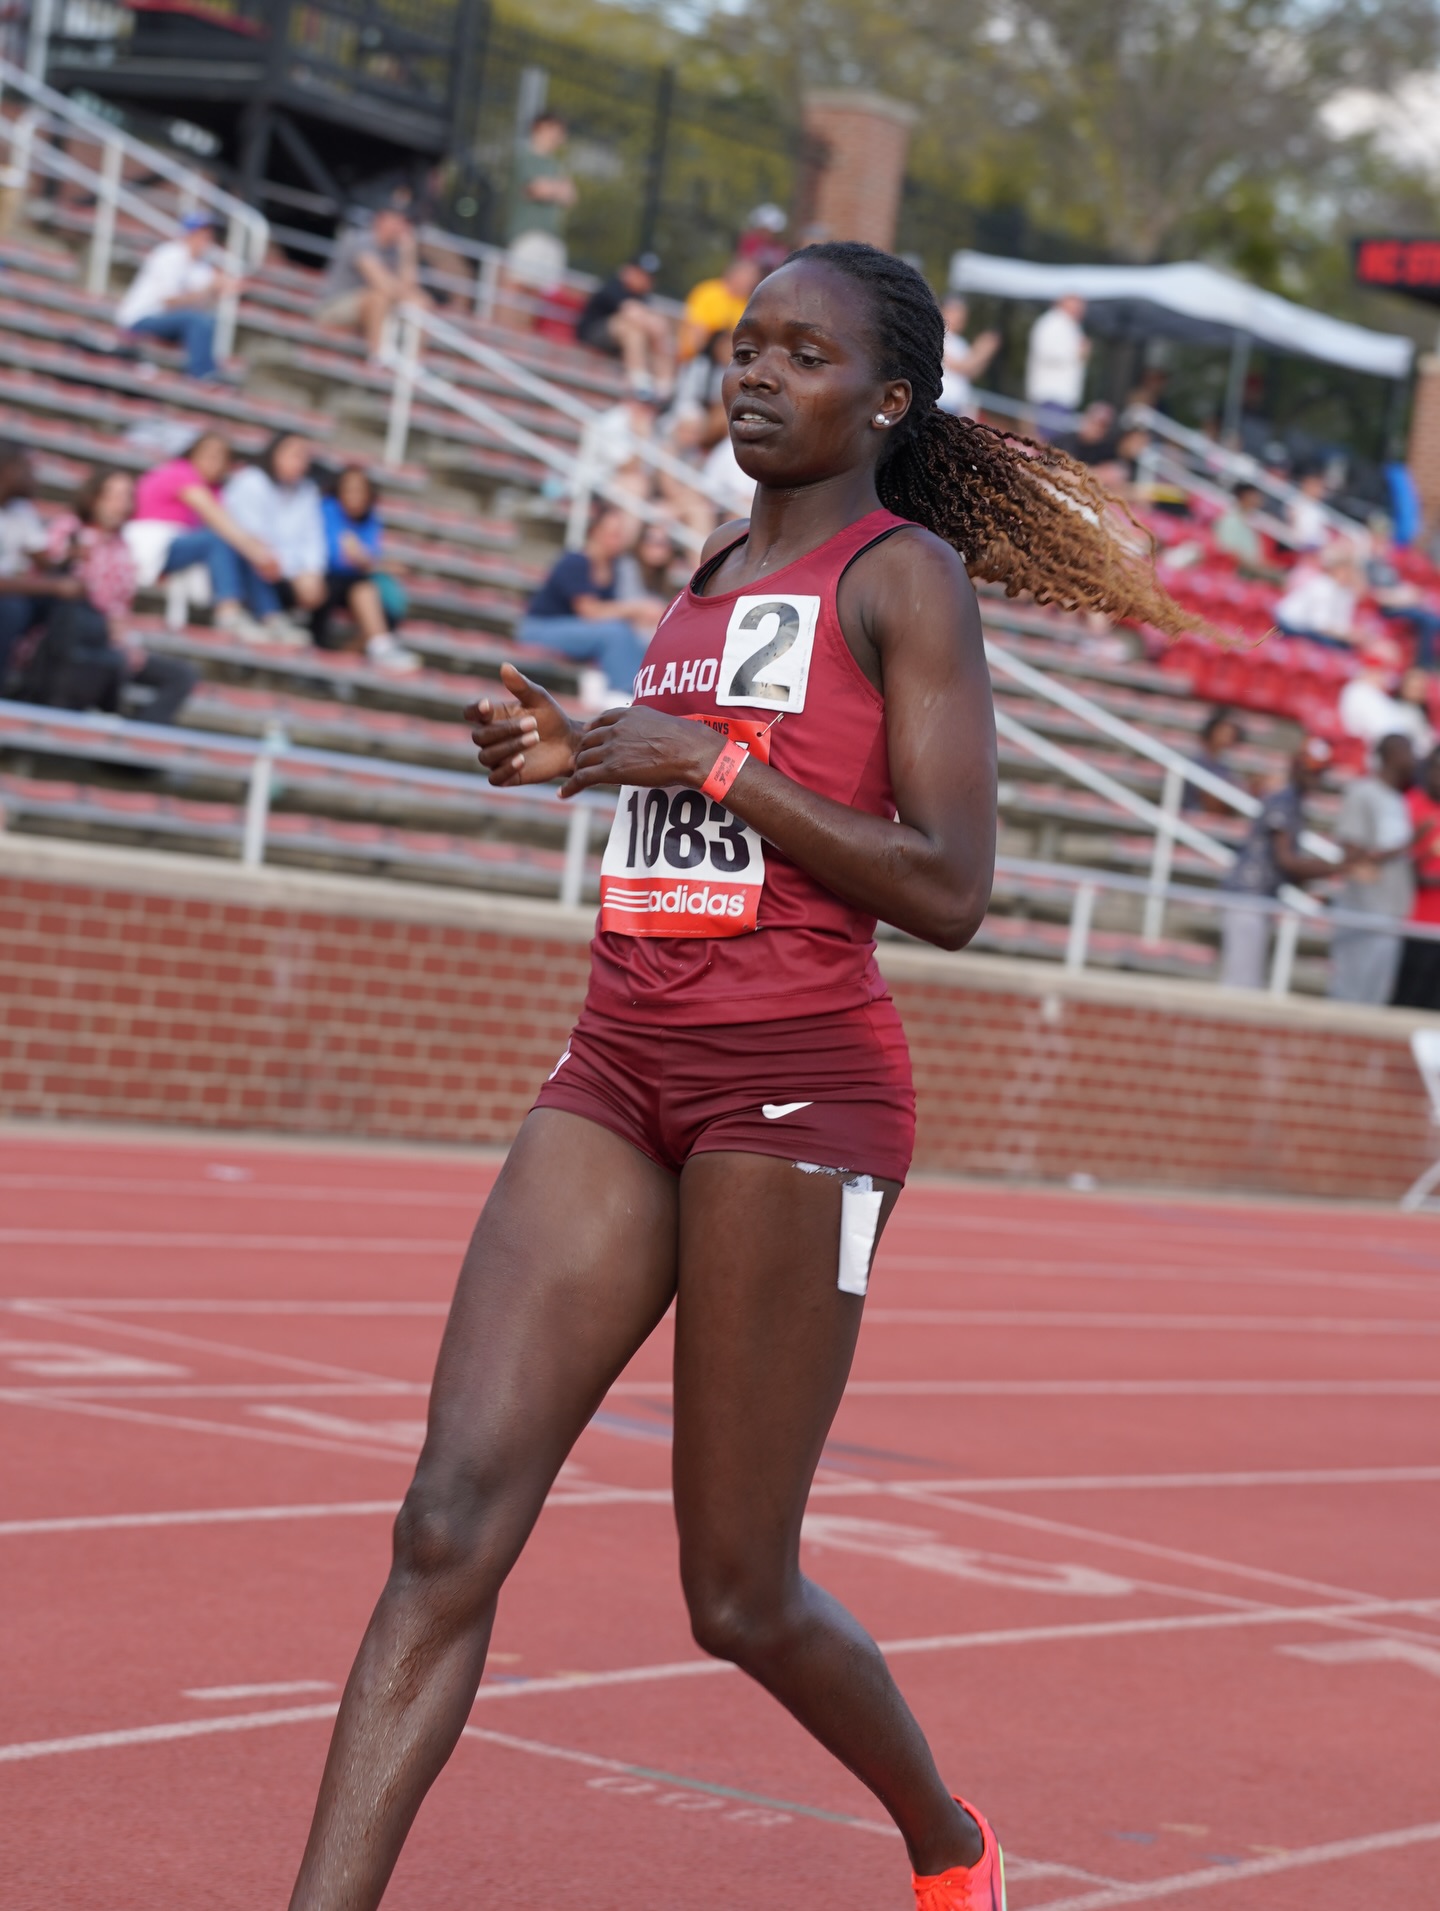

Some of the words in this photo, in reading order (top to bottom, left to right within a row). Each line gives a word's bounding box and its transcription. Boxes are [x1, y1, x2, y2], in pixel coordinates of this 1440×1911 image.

[633, 658, 718, 700] KLAHO
[729, 602, 800, 701] 2
[626, 789, 750, 872] 1083
[649, 885, 745, 917] adidas
